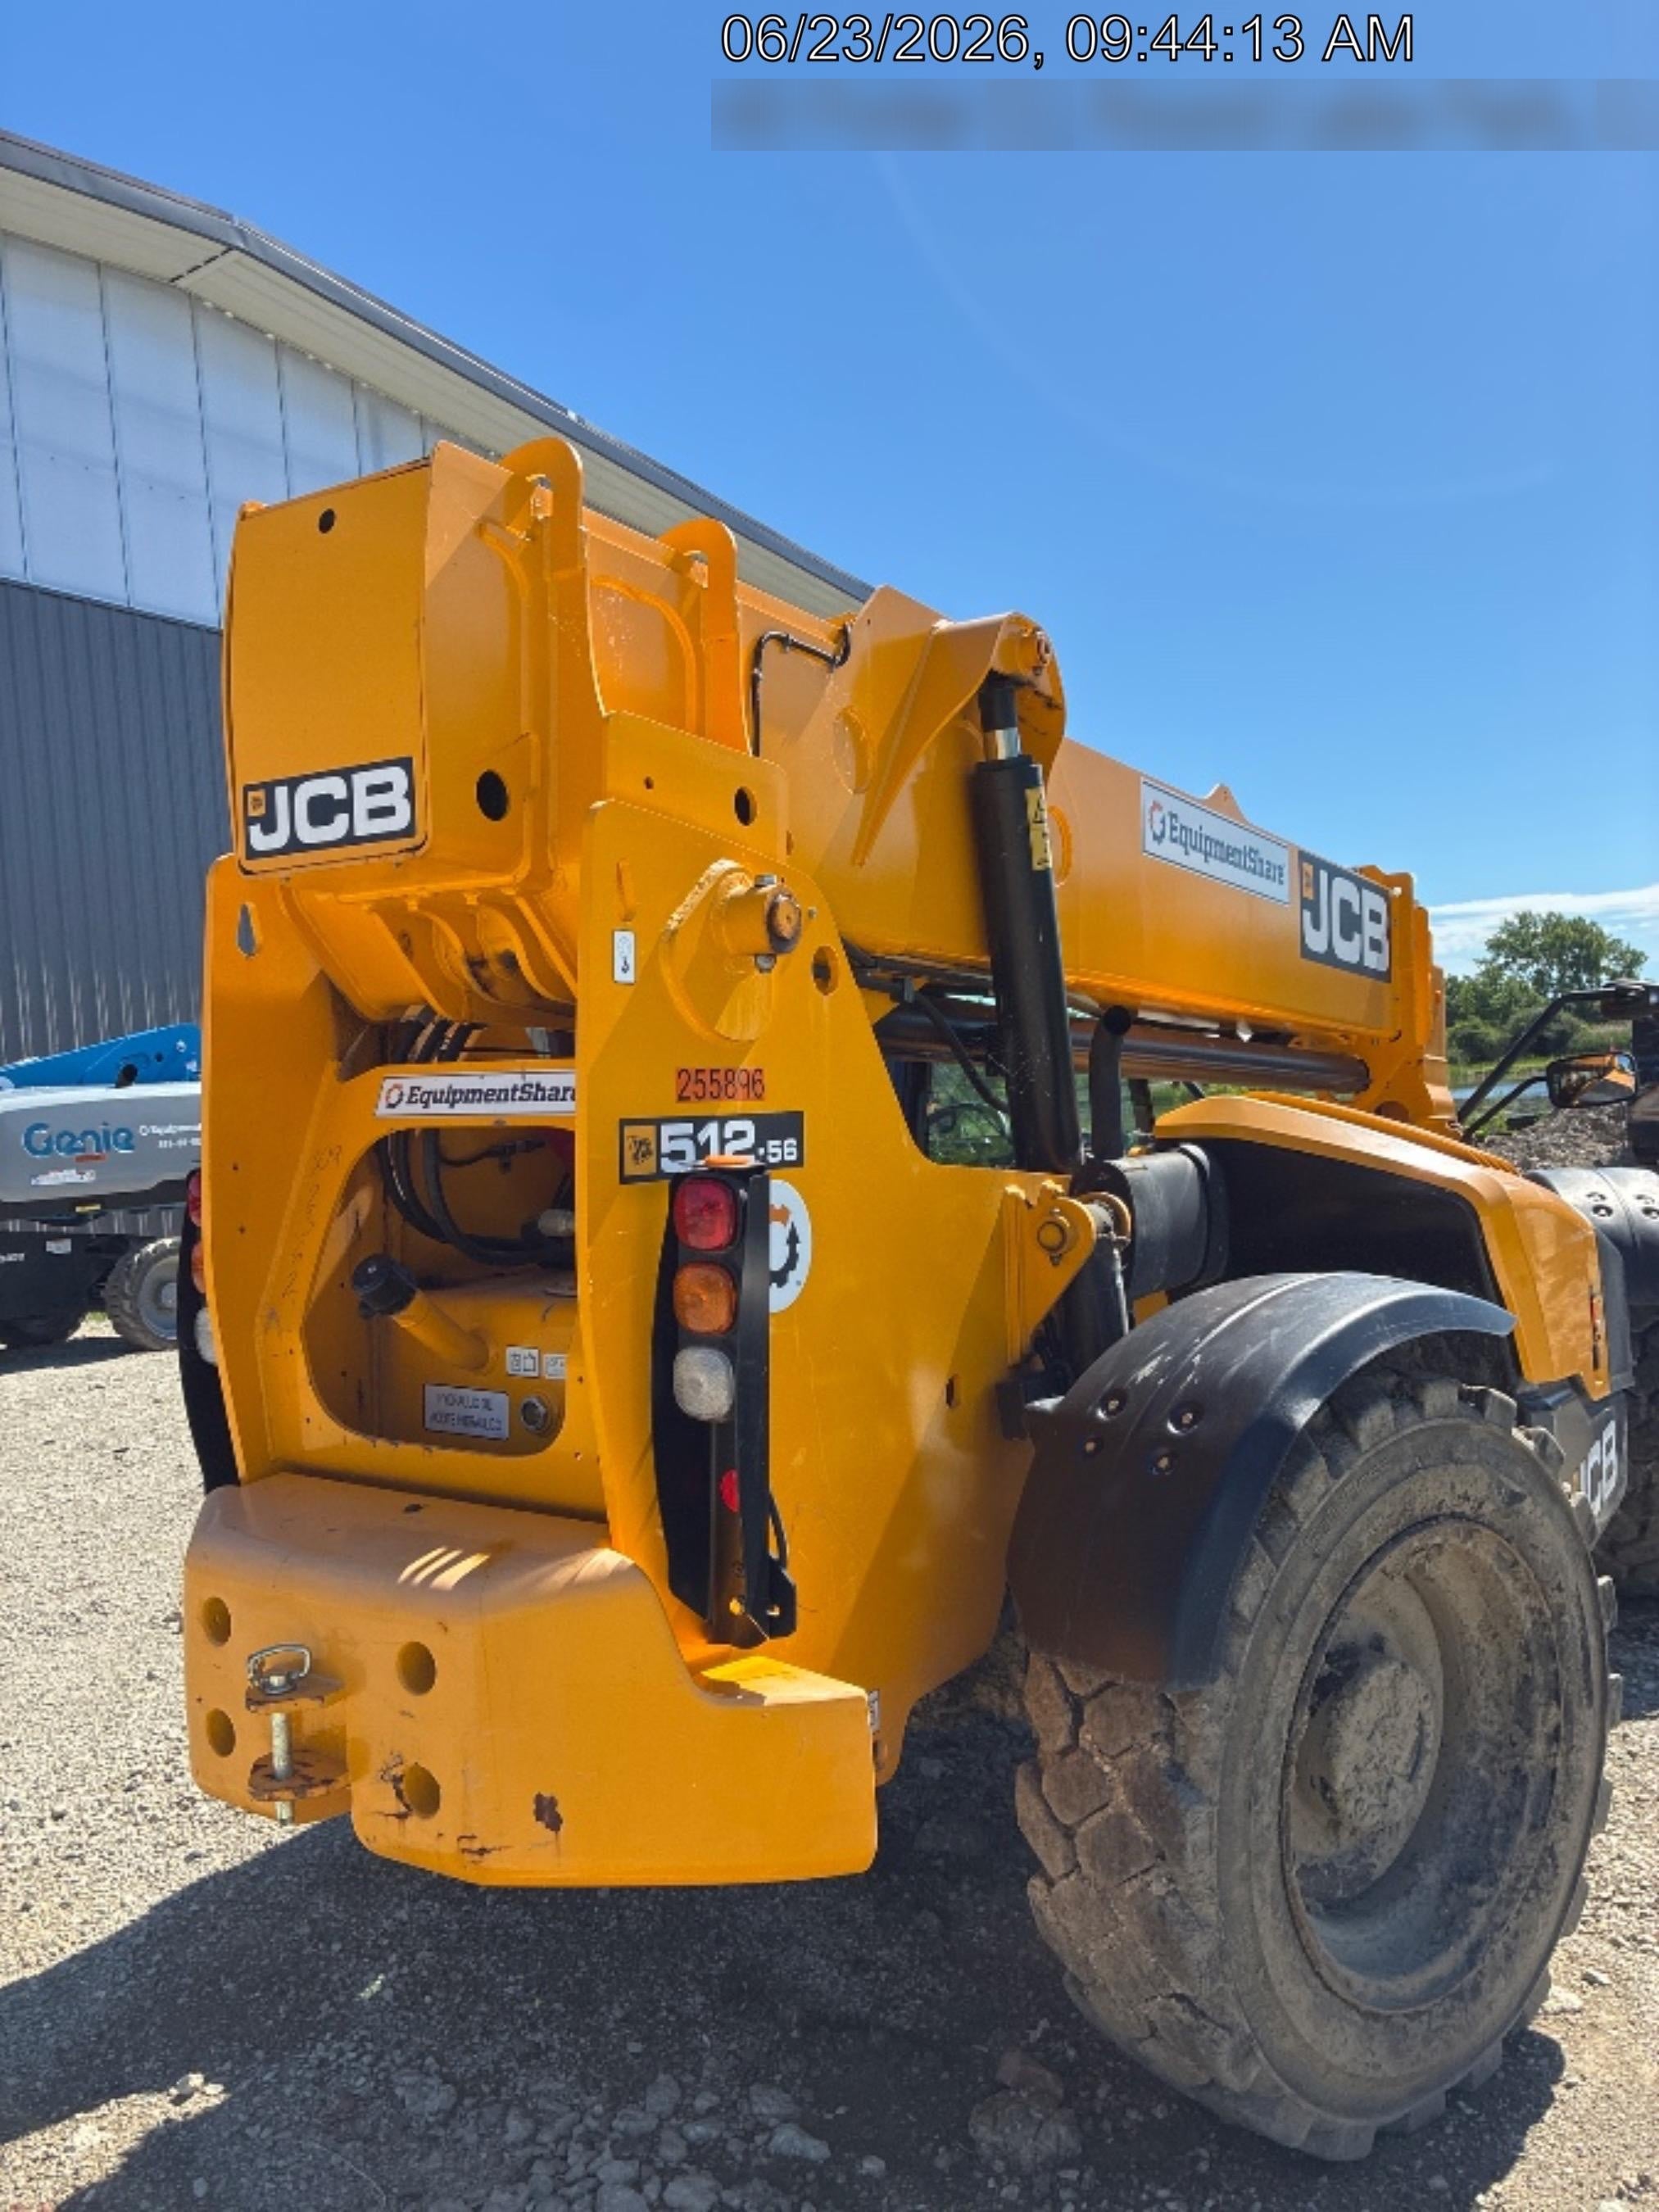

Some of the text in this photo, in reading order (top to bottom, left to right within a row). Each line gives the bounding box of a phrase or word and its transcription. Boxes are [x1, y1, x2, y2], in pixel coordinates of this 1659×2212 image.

[248, 766, 411, 851] JCB
[1167, 810, 1285, 886] EquipmentShare
[1302, 868, 1389, 972] JCB
[677, 1067, 765, 1102] 255896
[22, 1121, 136, 1158] Genie
